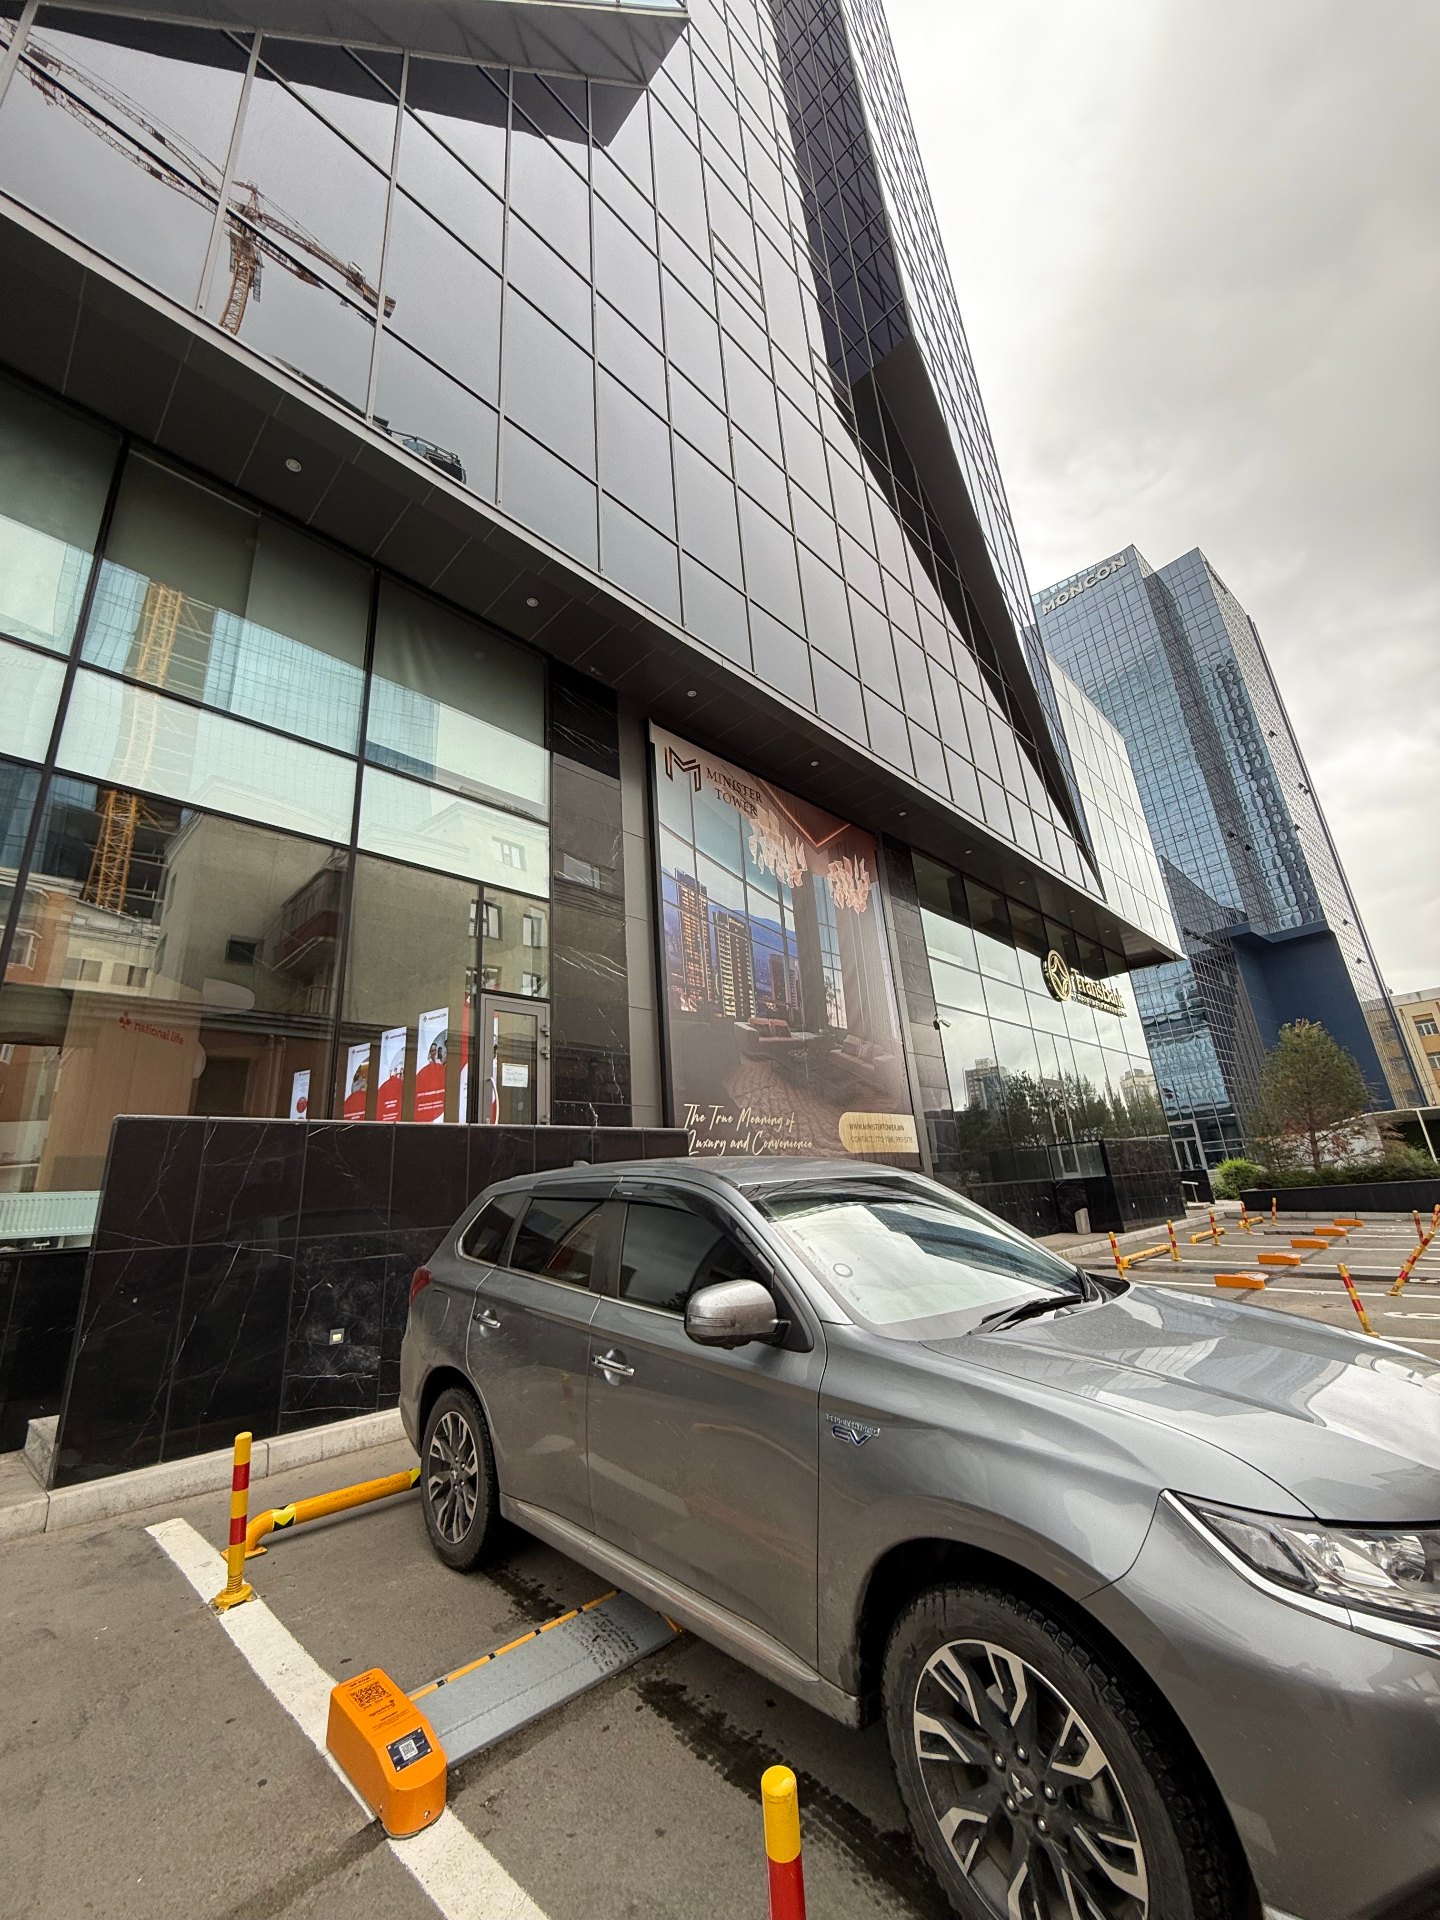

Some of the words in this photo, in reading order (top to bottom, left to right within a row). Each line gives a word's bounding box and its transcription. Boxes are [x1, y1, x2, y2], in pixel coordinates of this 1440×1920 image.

[1042, 555, 1127, 615] MONCON
[706, 767, 763, 803] MINISTER
[714, 788, 758, 817] TOWER
[134, 1022, 169, 1041] national
[171, 1031, 184, 1045] life
[684, 1103, 706, 1129] The
[709, 1105, 734, 1131] True
[736, 1106, 783, 1133] Meaning
[786, 1112, 795, 1133] of
[689, 1129, 727, 1157] Luxury
[730, 1131, 751, 1152] and
[752, 1130, 813, 1155] Convenience
